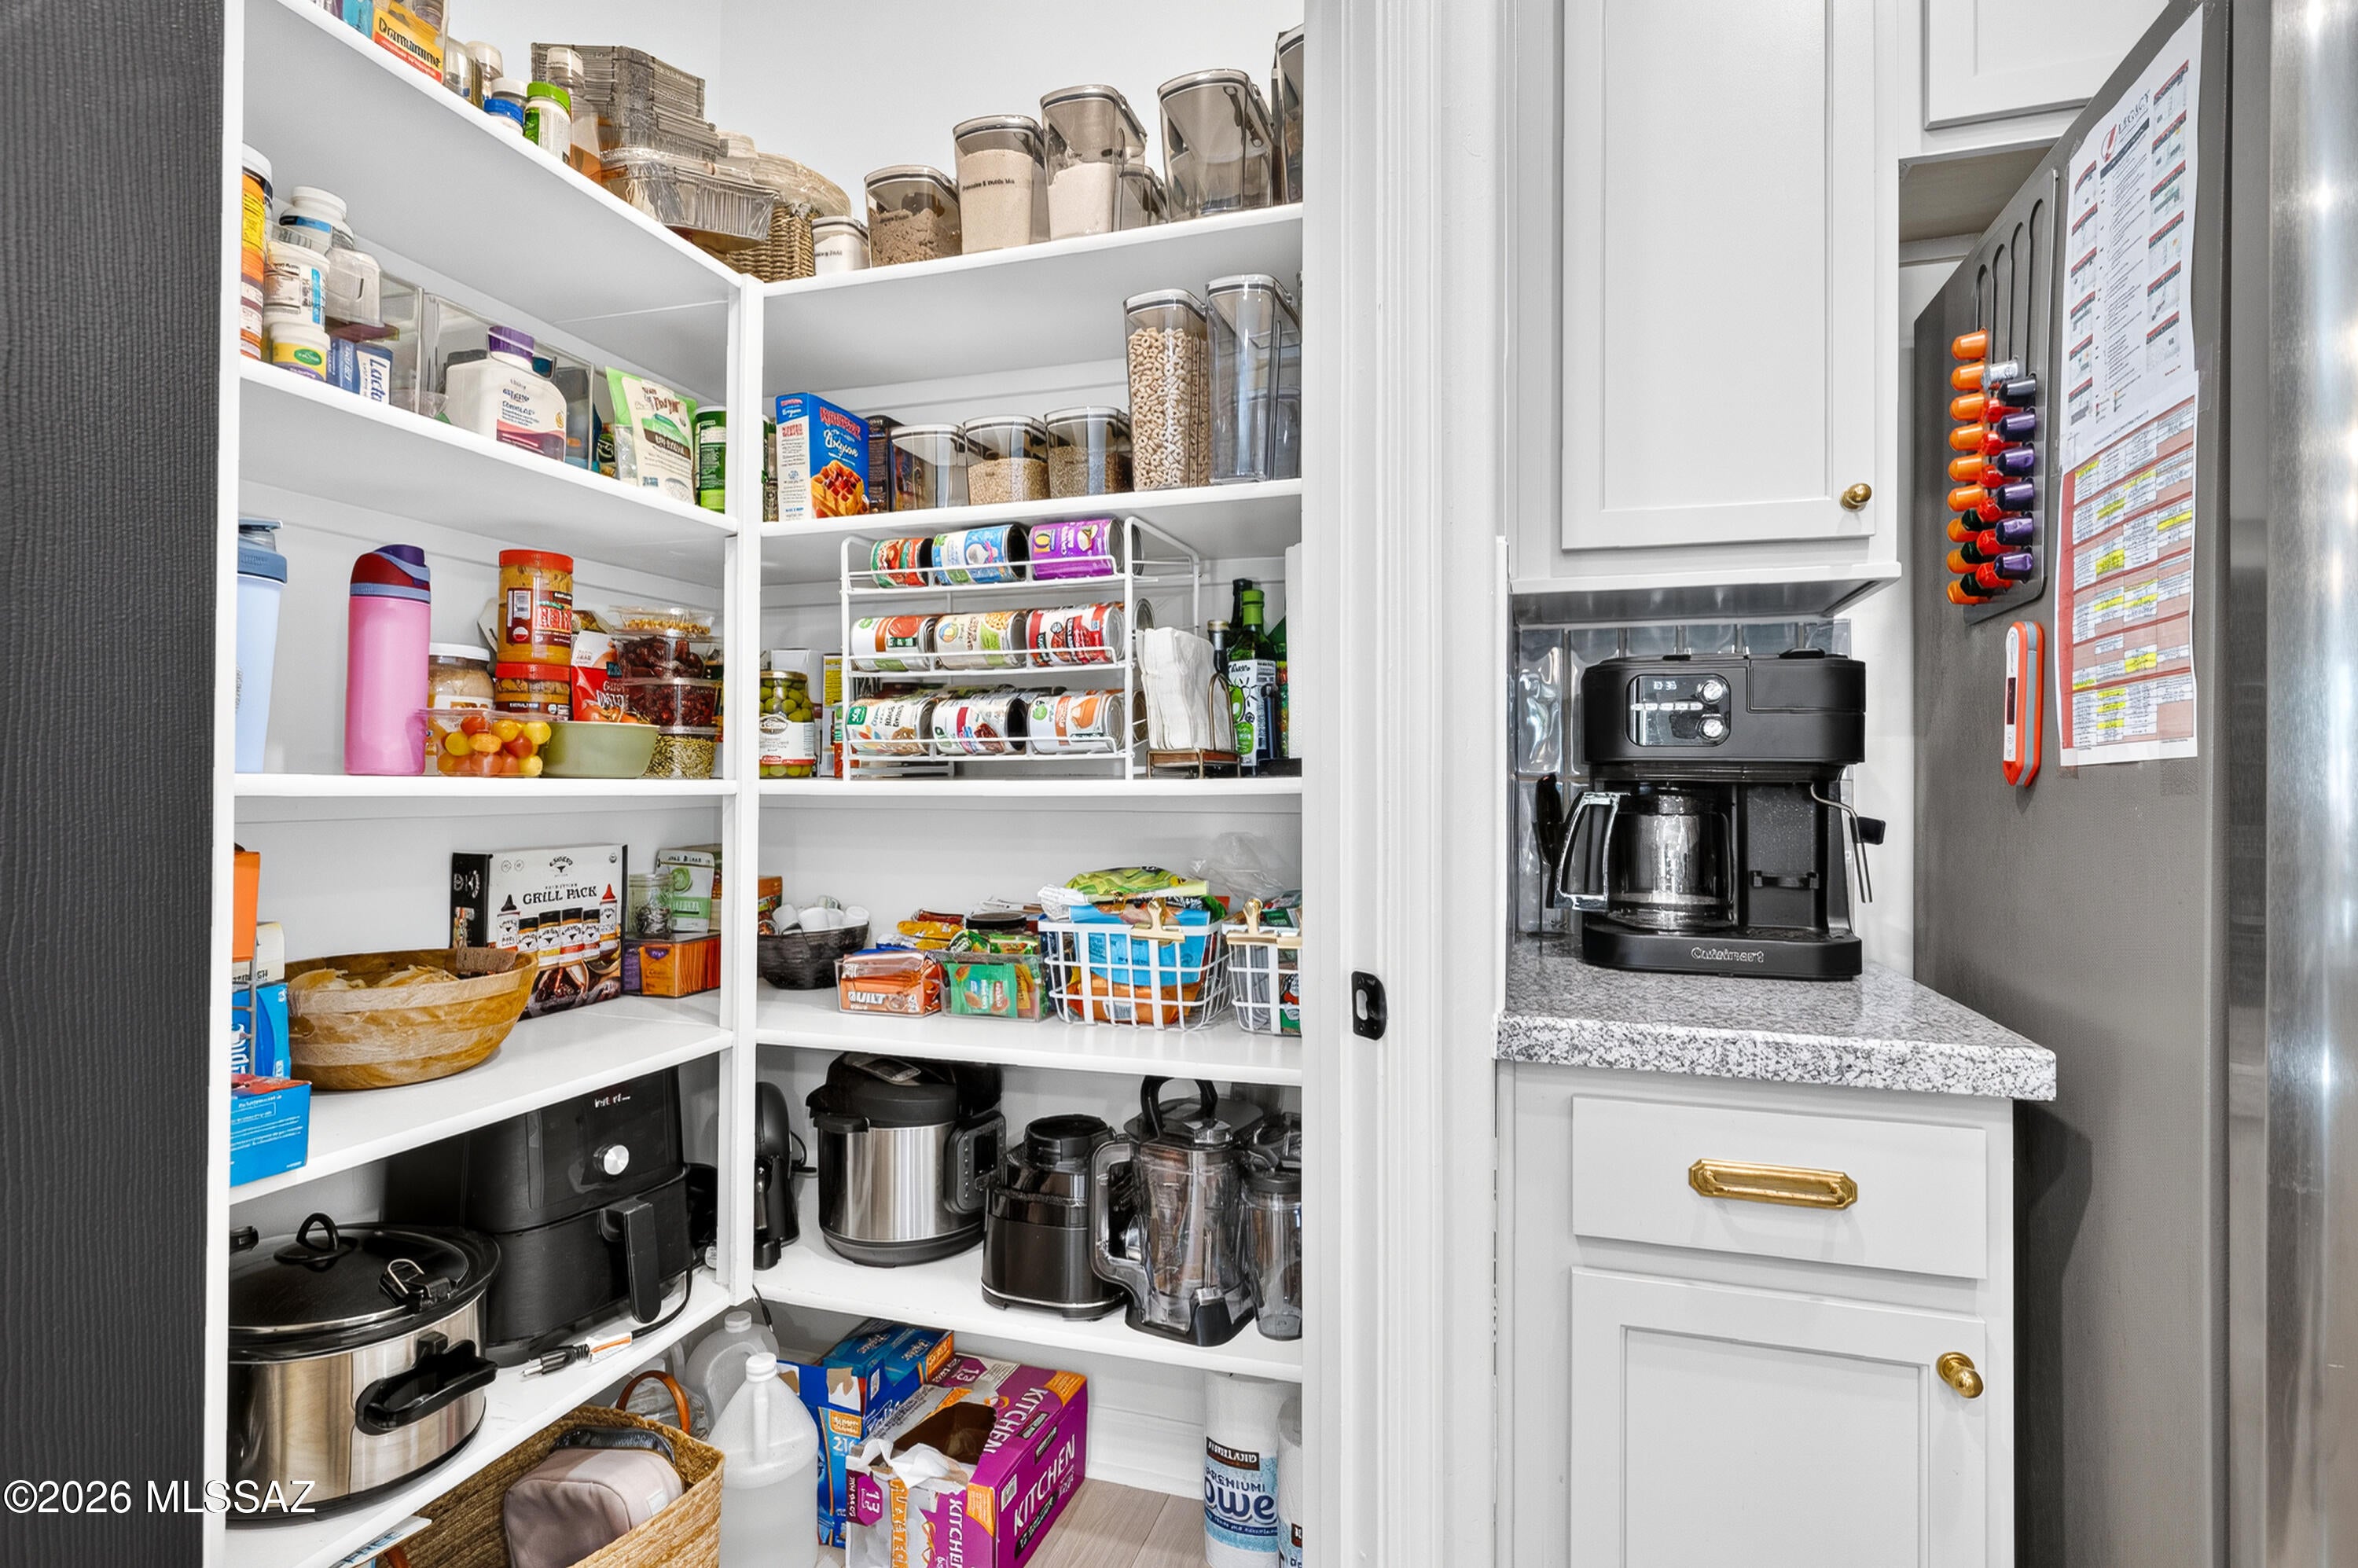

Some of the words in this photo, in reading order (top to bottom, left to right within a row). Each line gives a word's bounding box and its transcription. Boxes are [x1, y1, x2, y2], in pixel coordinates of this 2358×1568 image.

[522, 891, 564, 905] GRILL
[566, 885, 598, 900] PACK
[1691, 946, 1765, 964] Cuisinart
[983, 1387, 1049, 1454] KITCHEN
[1014, 1434, 1075, 1536] KITCHEN
